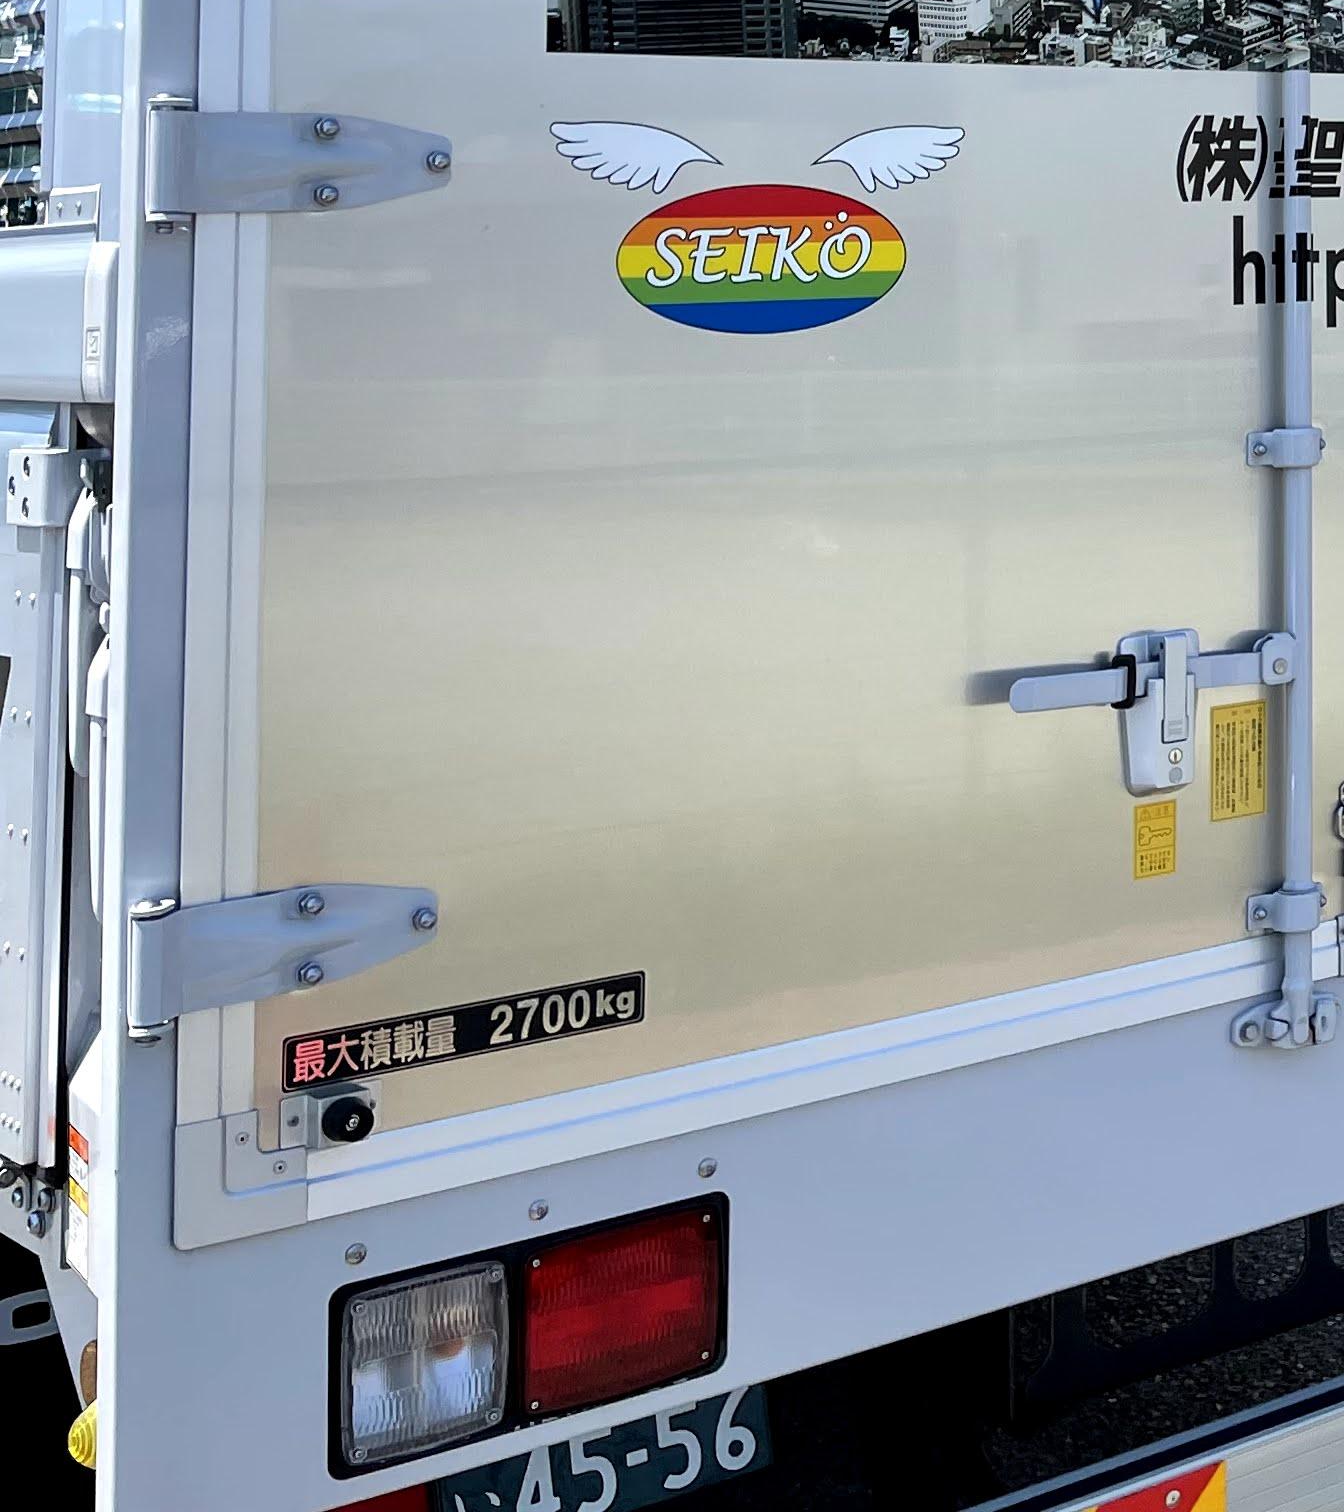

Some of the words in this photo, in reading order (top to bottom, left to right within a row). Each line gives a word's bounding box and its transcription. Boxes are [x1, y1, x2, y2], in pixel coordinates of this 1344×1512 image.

[293, 1015, 456, 1084] 最大積載量
[490, 988, 636, 1046] 2700kg
[515, 1384, 757, 1512] 45-56
